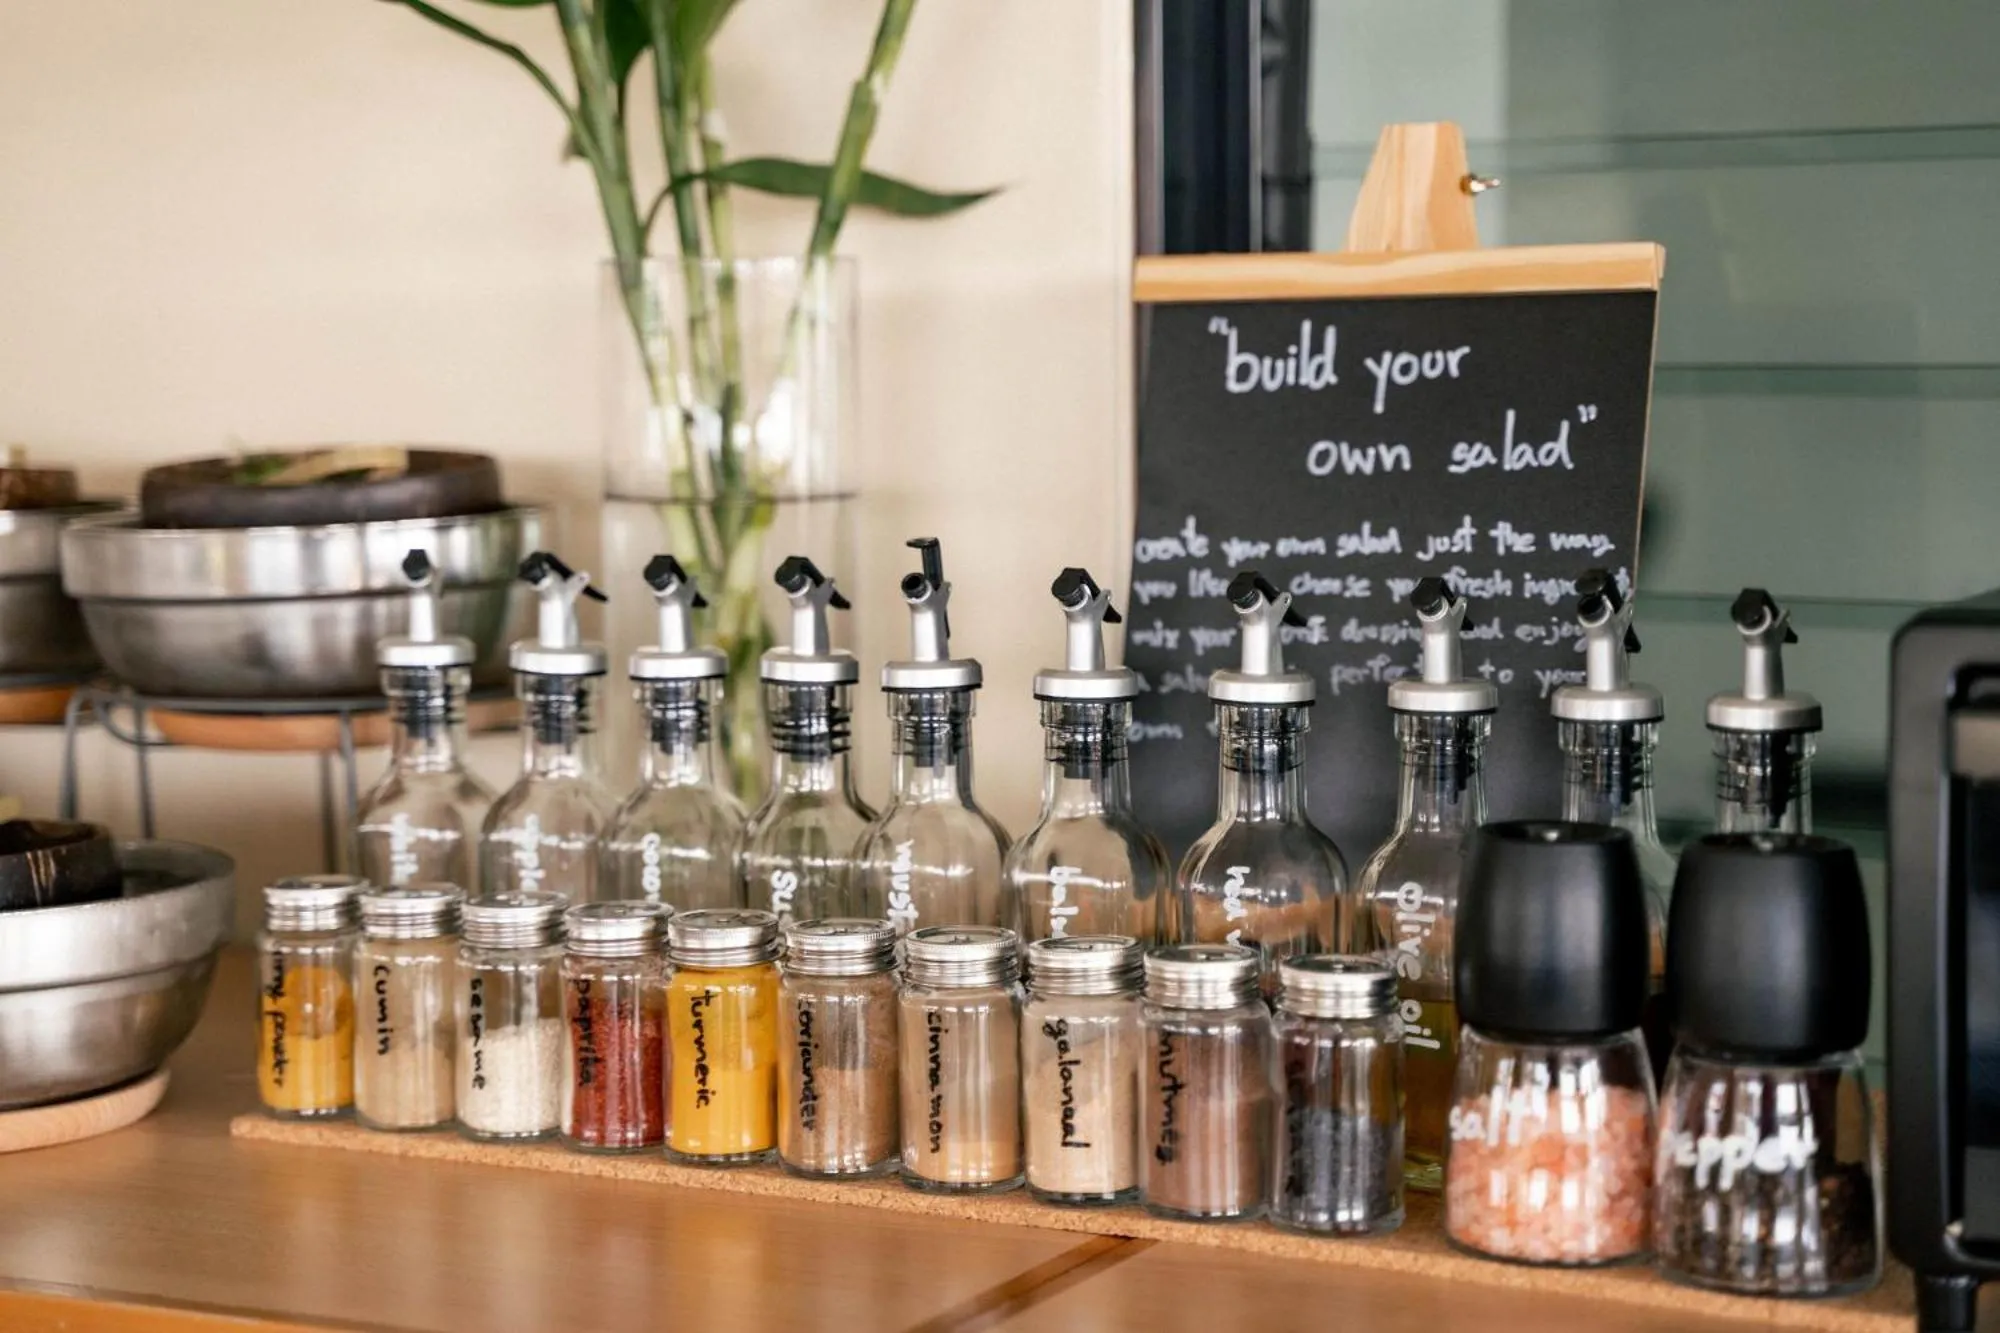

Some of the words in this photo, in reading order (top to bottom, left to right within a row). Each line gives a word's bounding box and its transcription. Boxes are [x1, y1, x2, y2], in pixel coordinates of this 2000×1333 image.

[1363, 344, 1471, 414] your
[1306, 439, 1412, 476] own
[1134, 515, 1209, 563] create
[1220, 536, 1271, 567] your
[1276, 536, 1327, 558] own
[1336, 520, 1402, 558] salad
[1416, 514, 1478, 562] just
[1489, 520, 1536, 556] the
[1549, 531, 1616, 559] way
[1133, 578, 1177, 605] you
[1440, 565, 1513, 600] fresh
[1131, 618, 1181, 650] mix
[1477, 657, 1514, 685] to
[1396, 881, 1436, 982] olive
[572, 978, 603, 1088] paprika
[691, 989, 721, 1110] turmeric
[1400, 999, 1442, 1051] oil
[1156, 1032, 1189, 1166] nutmeg
[1448, 1083, 1527, 1148] salt
[1655, 1129, 1820, 1193] pepper
